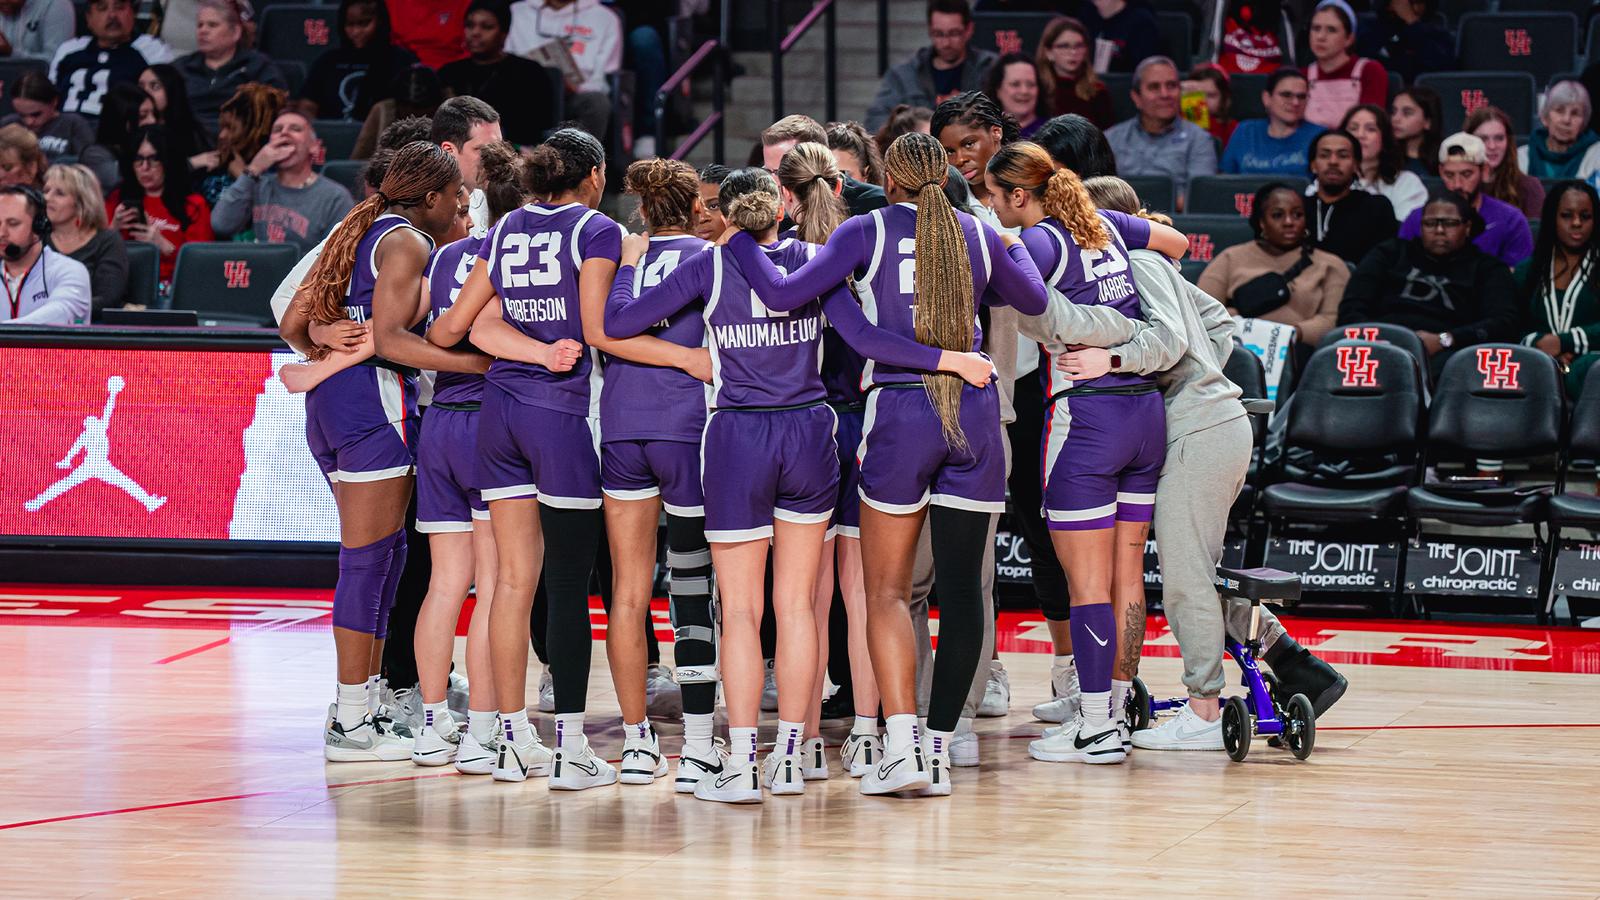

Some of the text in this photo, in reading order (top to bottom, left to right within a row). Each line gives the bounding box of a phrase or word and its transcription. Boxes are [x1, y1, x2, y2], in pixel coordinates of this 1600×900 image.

[1504, 28, 1531, 56] UH
[63, 68, 111, 116] 11
[224, 260, 252, 289] UH
[501, 231, 563, 289] 23
[1265, 326, 1281, 374] OWERADE
[1336, 346, 1379, 387] UH
[1476, 348, 1520, 390] UH
[1288, 540, 1379, 572] THE JOINT
[1427, 543, 1521, 578] THE JOINT
[1422, 575, 1517, 591] chiropractic
